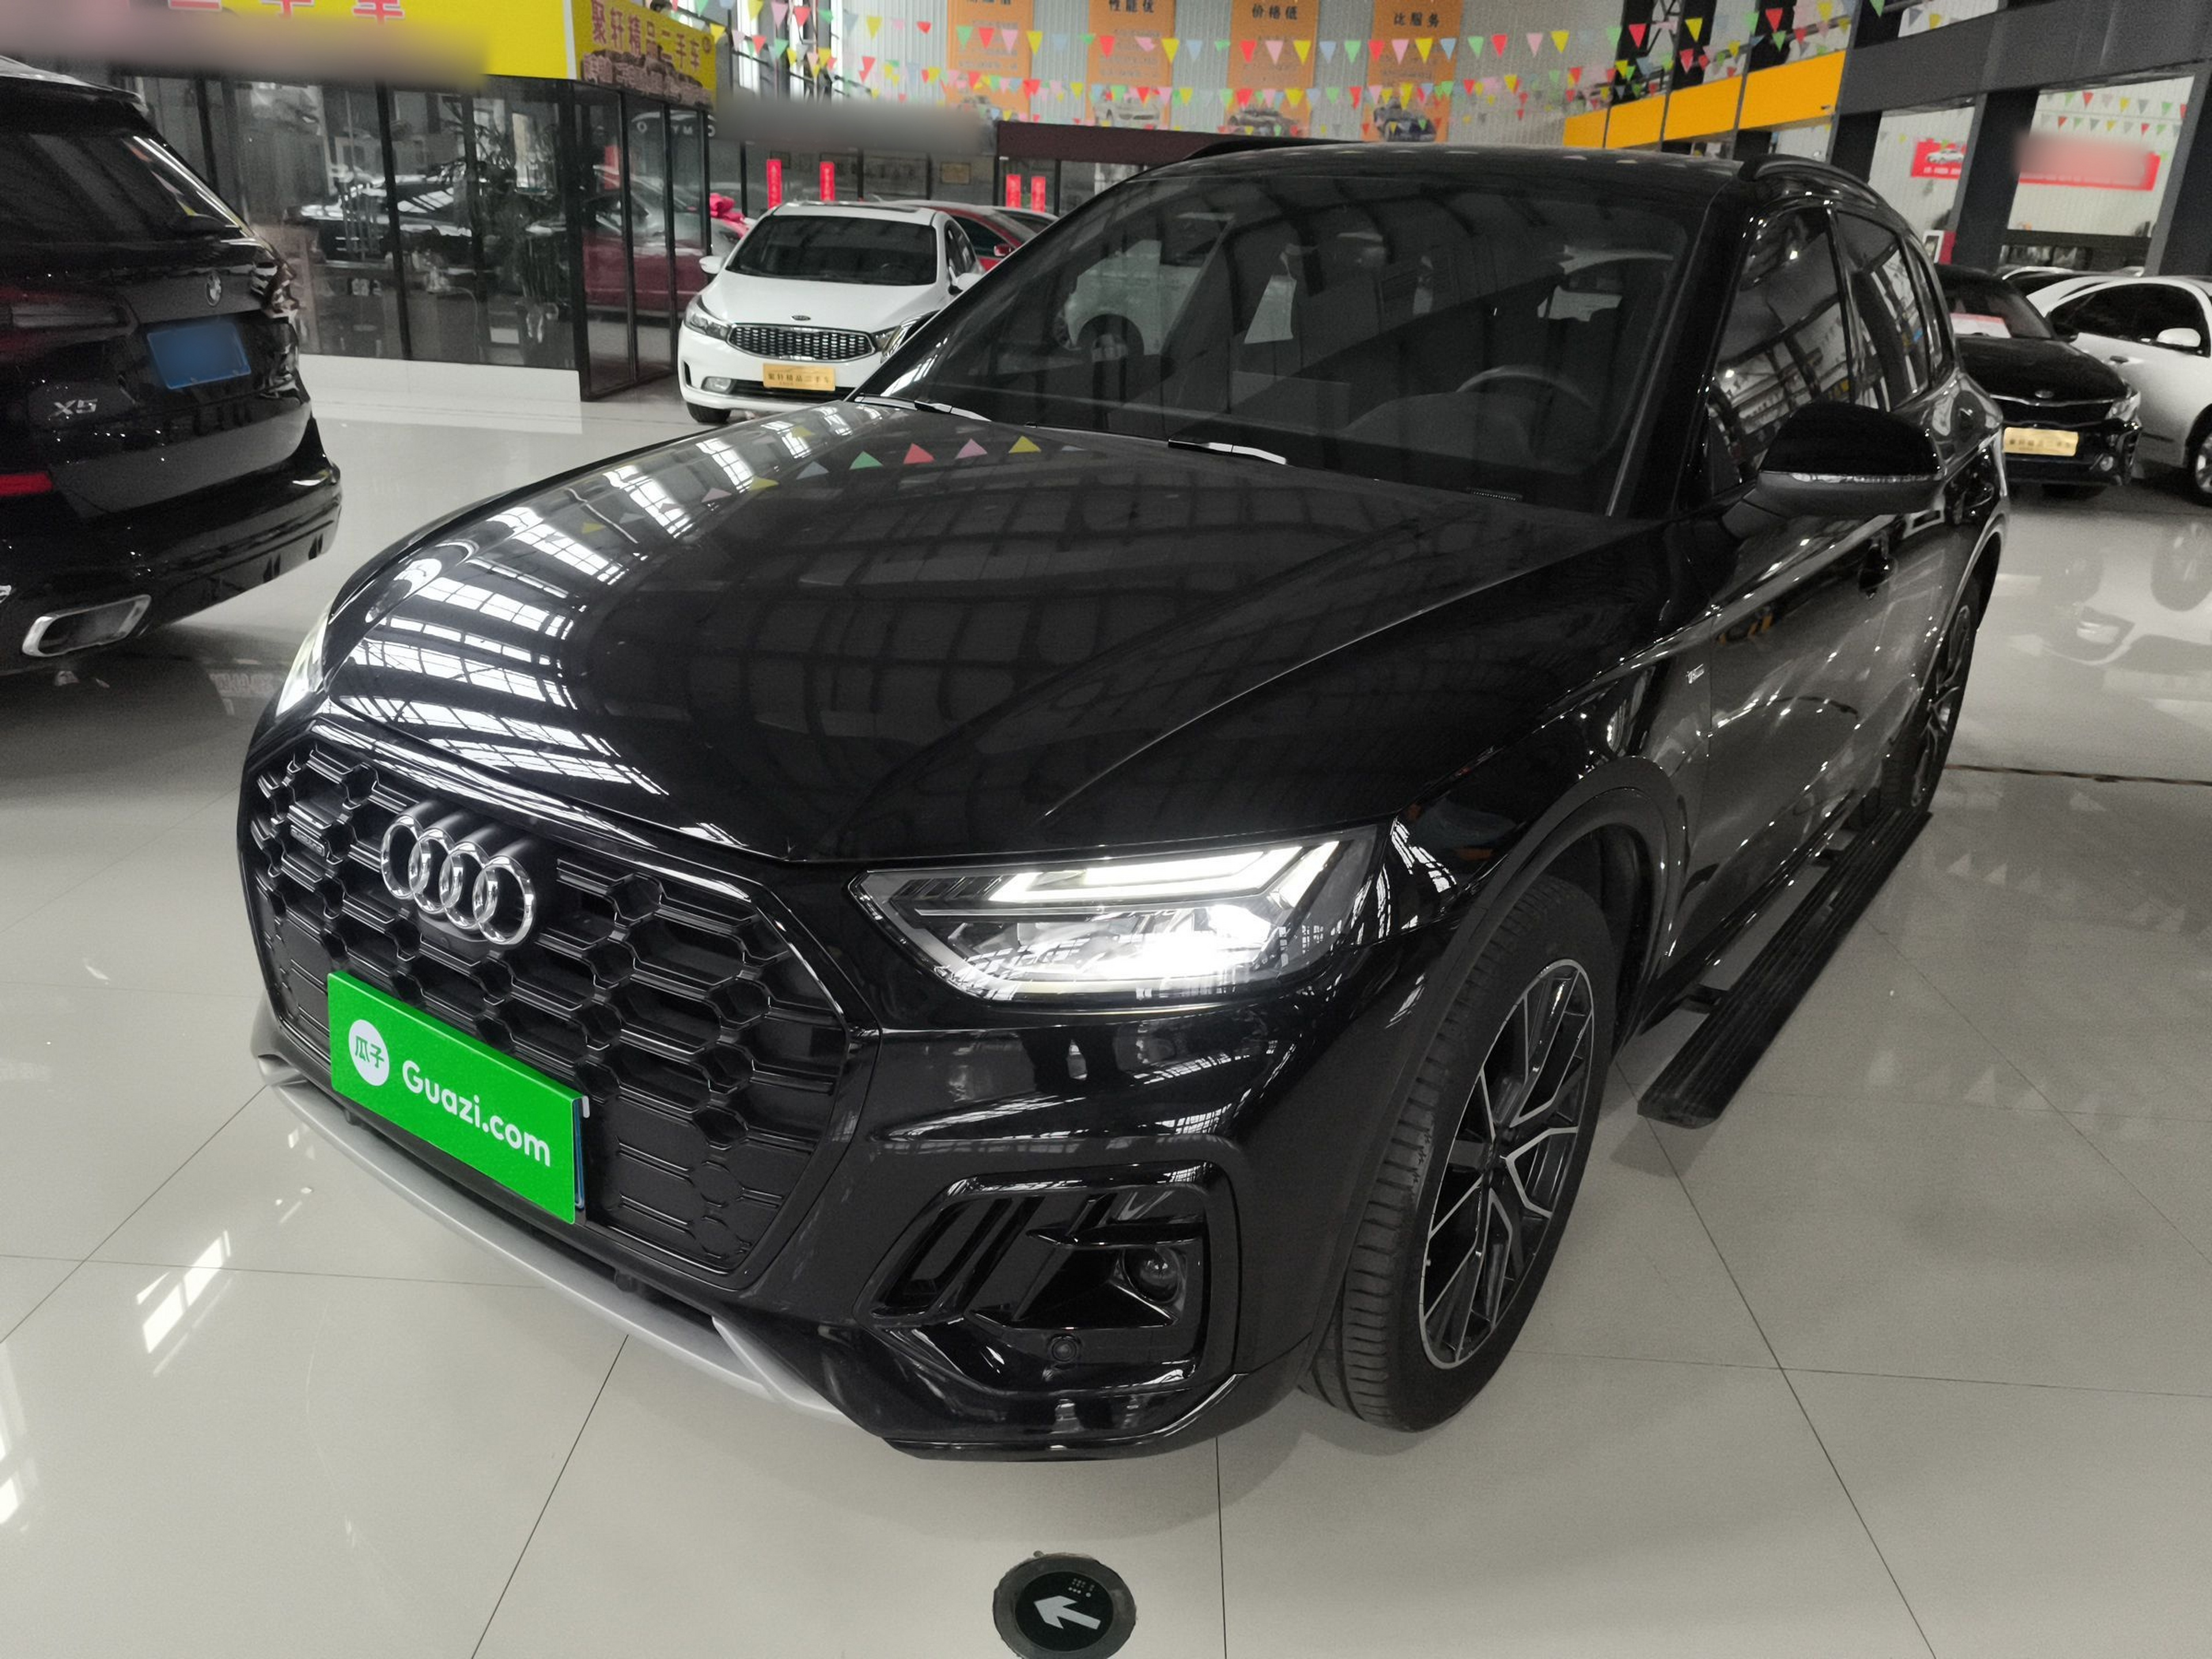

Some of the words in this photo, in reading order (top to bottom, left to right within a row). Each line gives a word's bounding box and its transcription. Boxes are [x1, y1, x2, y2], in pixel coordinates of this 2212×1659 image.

[1251, 4, 1298, 20] 价格低
[50, 399, 97, 416] X5
[354, 1035, 385, 1069] 瓜子
[402, 1060, 551, 1167] Guazi.com
